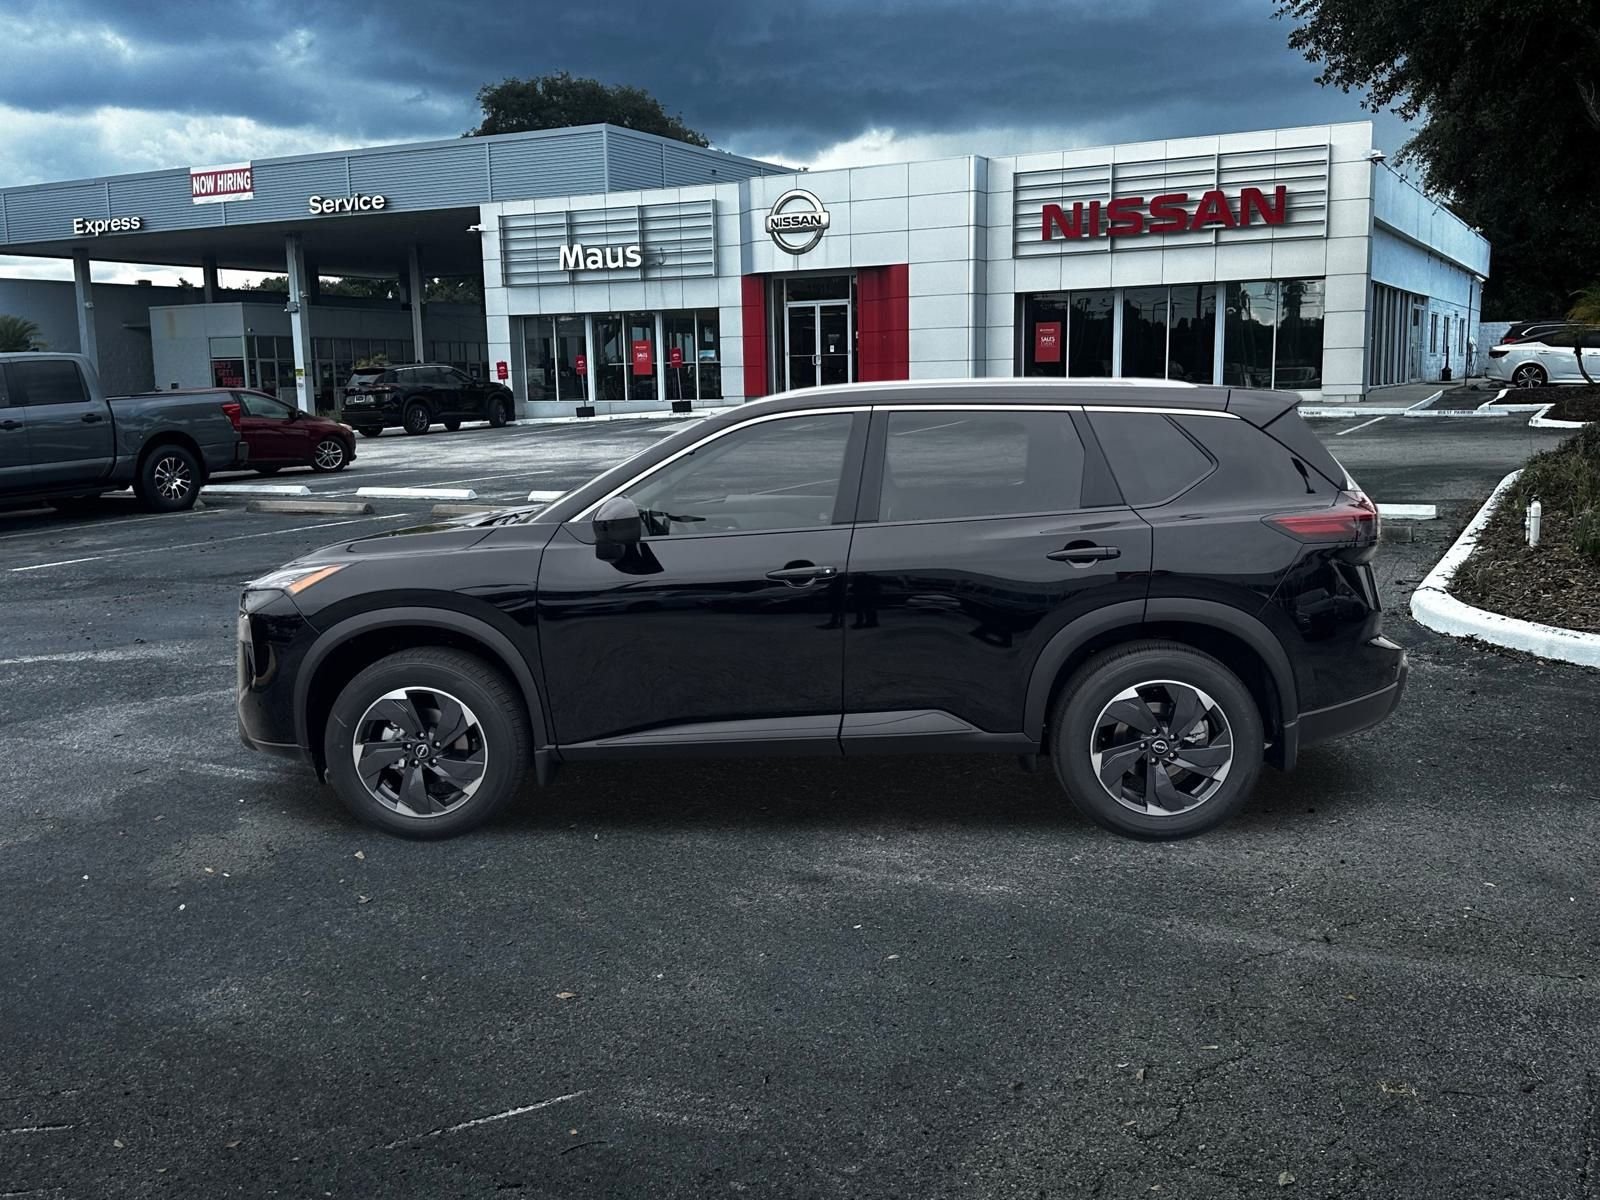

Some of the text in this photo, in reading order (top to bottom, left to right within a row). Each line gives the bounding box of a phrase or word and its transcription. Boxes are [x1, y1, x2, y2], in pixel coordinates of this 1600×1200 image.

[192, 171, 251, 195] NOW HIRING
[309, 193, 385, 215] Service
[1042, 185, 1287, 241] NISSAN
[73, 216, 141, 237] Express
[770, 214, 822, 228] NISSAN
[559, 243, 642, 271] Maus
